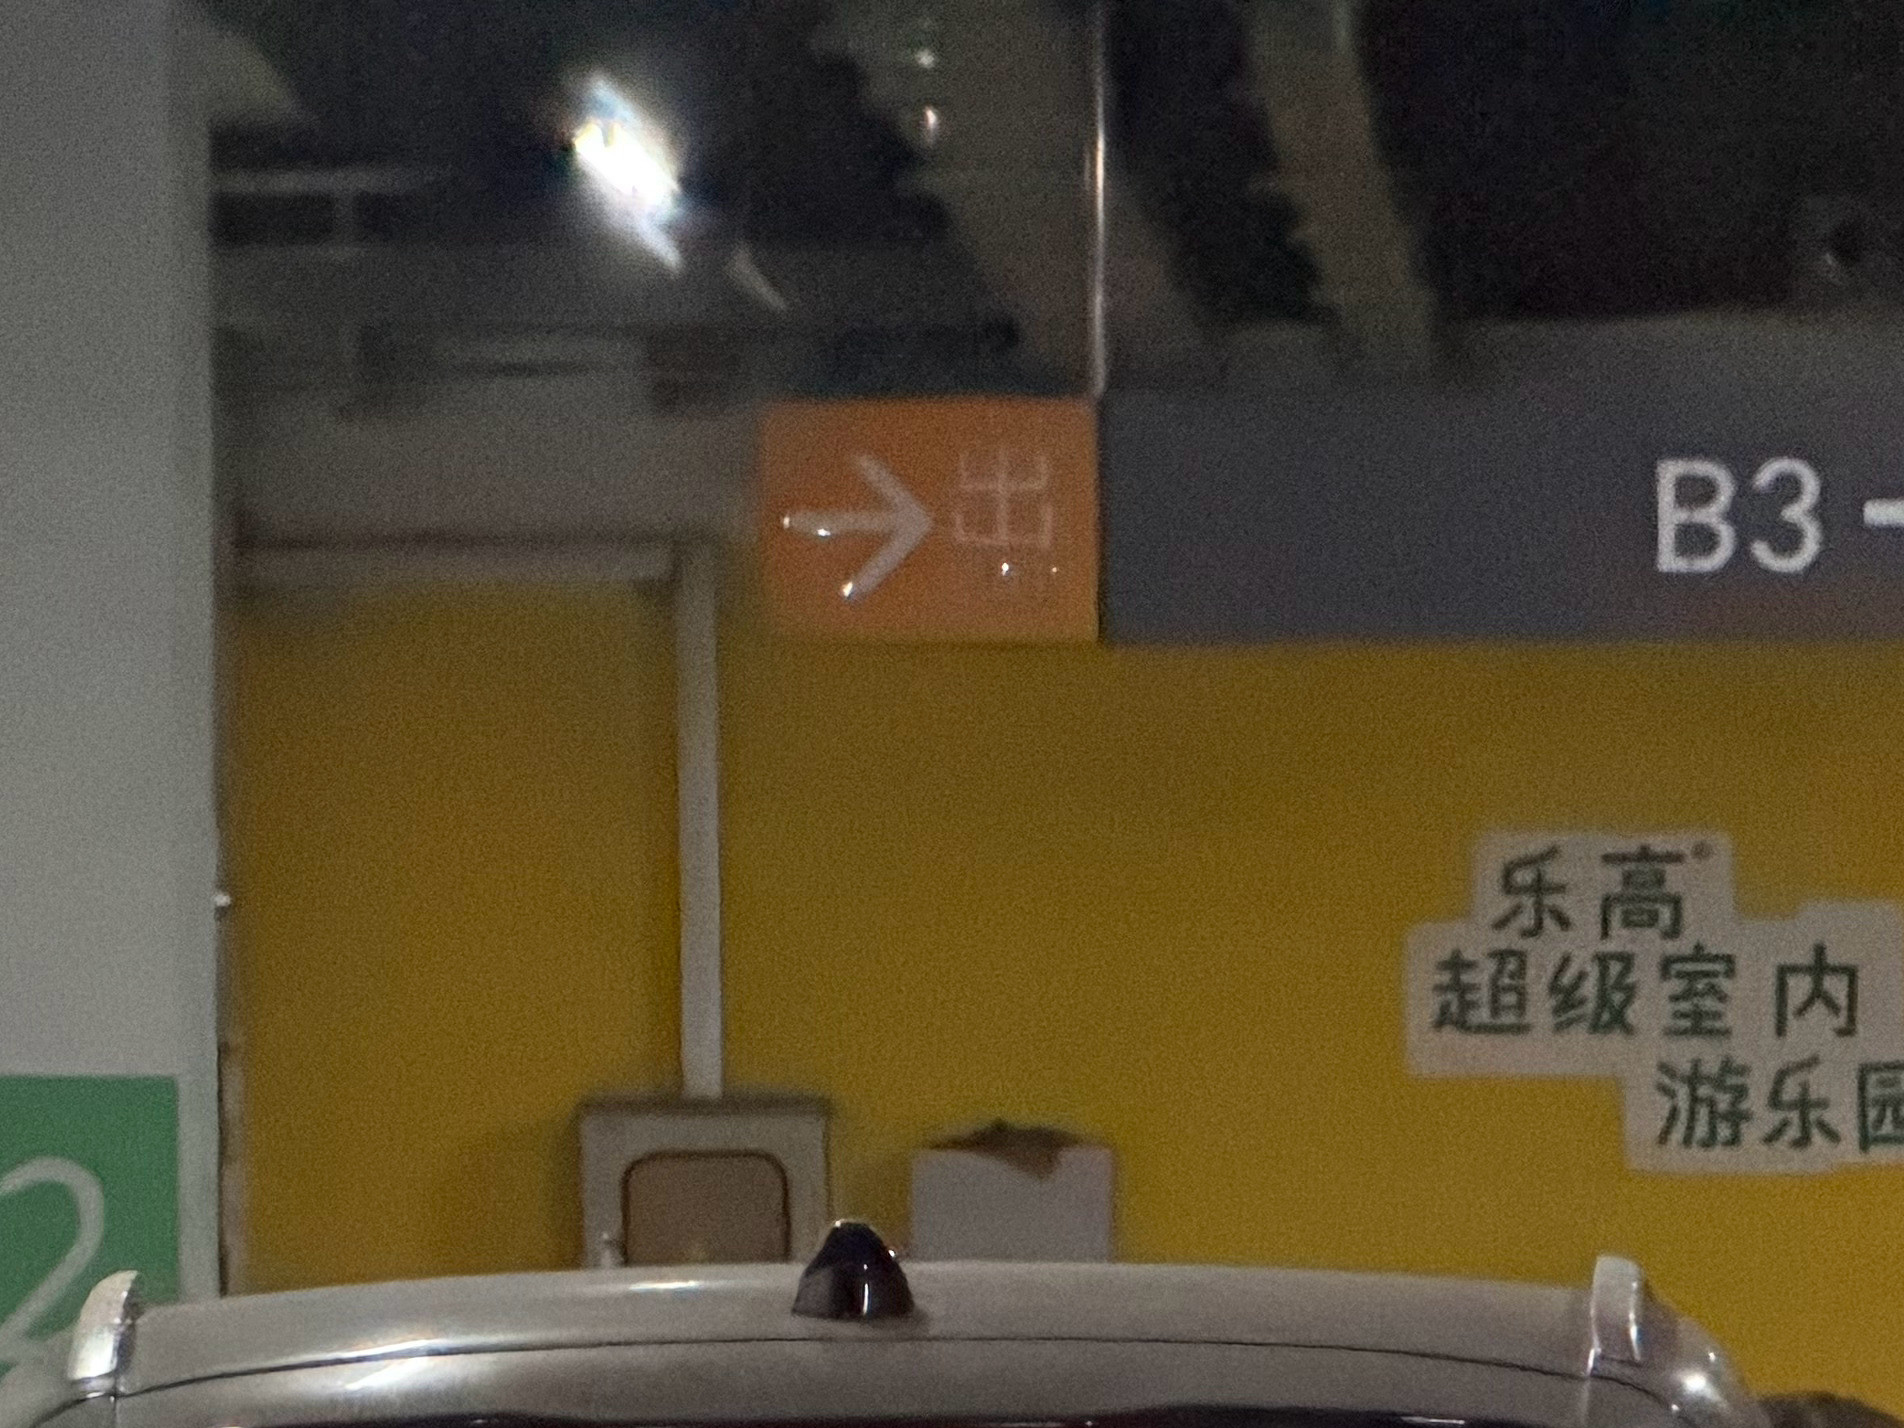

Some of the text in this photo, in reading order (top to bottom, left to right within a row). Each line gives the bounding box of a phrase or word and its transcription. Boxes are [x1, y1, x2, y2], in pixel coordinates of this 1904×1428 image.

[1655, 457, 1824, 574] B3
[1491, 843, 1698, 942] 乐高
[1429, 944, 1862, 1039] 超级室内
